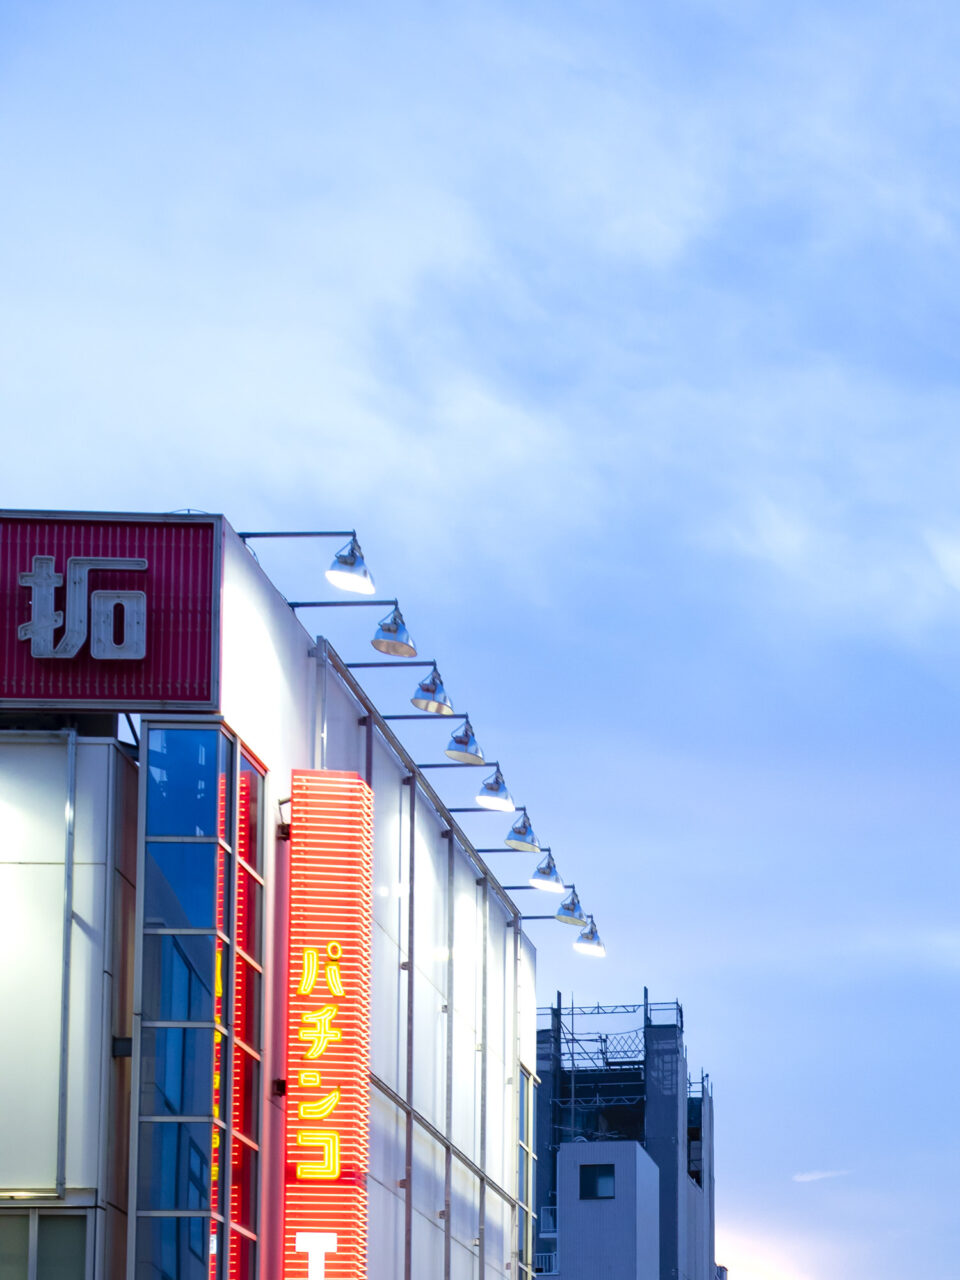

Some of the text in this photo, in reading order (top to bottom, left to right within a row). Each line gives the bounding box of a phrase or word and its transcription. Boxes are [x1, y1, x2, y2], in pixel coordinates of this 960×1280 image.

[18, 555, 148, 659] 拓
[296, 941, 346, 1180] パチンコ
